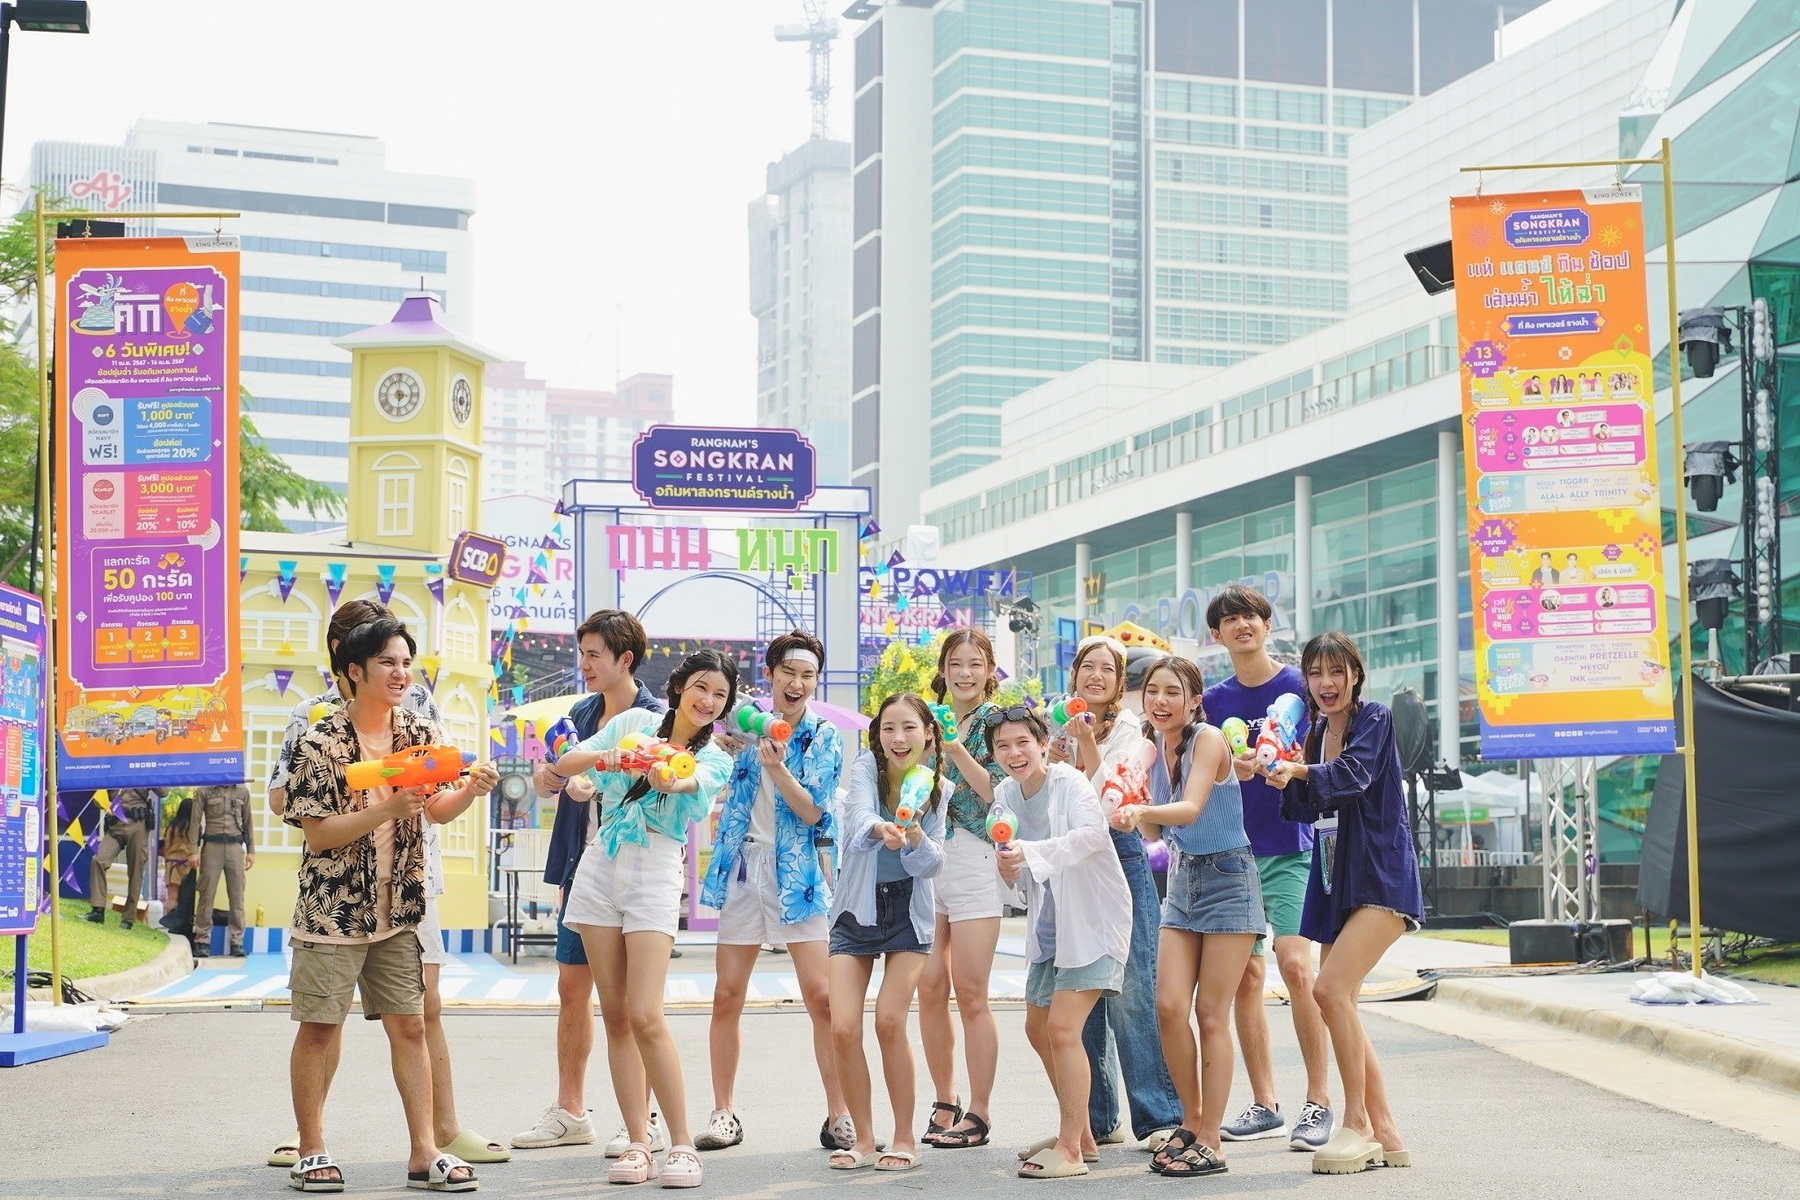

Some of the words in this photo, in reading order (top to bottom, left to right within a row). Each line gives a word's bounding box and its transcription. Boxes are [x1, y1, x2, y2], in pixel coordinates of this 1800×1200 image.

[71, 171, 131, 209] Aj
[1513, 218, 1580, 230] SONGKRAN
[1590, 250, 1630, 269] ช้อป
[105, 343, 116, 358] 6
[121, 341, 191, 358] วันพิเศษ!
[1476, 346, 1492, 359] 13
[141, 410, 173, 422] 1,000
[691, 437, 759, 449] RANGNAM'S
[89, 443, 118, 459] ฟรี!
[653, 450, 795, 471] SONGKRAN
[686, 473, 764, 484] FESTIVAL
[1559, 477, 1589, 486] TIGGER
[140, 483, 174, 494] 3,000
[655, 484, 795, 500] อภิมหาสงกรานต์รางน้ำ
[1570, 490, 1591, 499] ALLY
[1594, 488, 1628, 497] TRINITY
[1485, 526, 1502, 538] 14
[104, 554, 150, 567] แลกกะรัต
[460, 547, 490, 573] SCB
[104, 567, 136, 591] 50
[142, 568, 193, 588] กะรัต
[103, 592, 154, 605] เพื่อรับคูปอง
[155, 591, 174, 601] 100
[175, 592, 193, 600] บาท
[108, 632, 115, 643] 1
[144, 631, 152, 642] 2
[179, 629, 187, 640] 3
[1496, 652, 1521, 660] WATER
[1589, 650, 1639, 660] PRETZELLE
[1569, 675, 1587, 683] INK
